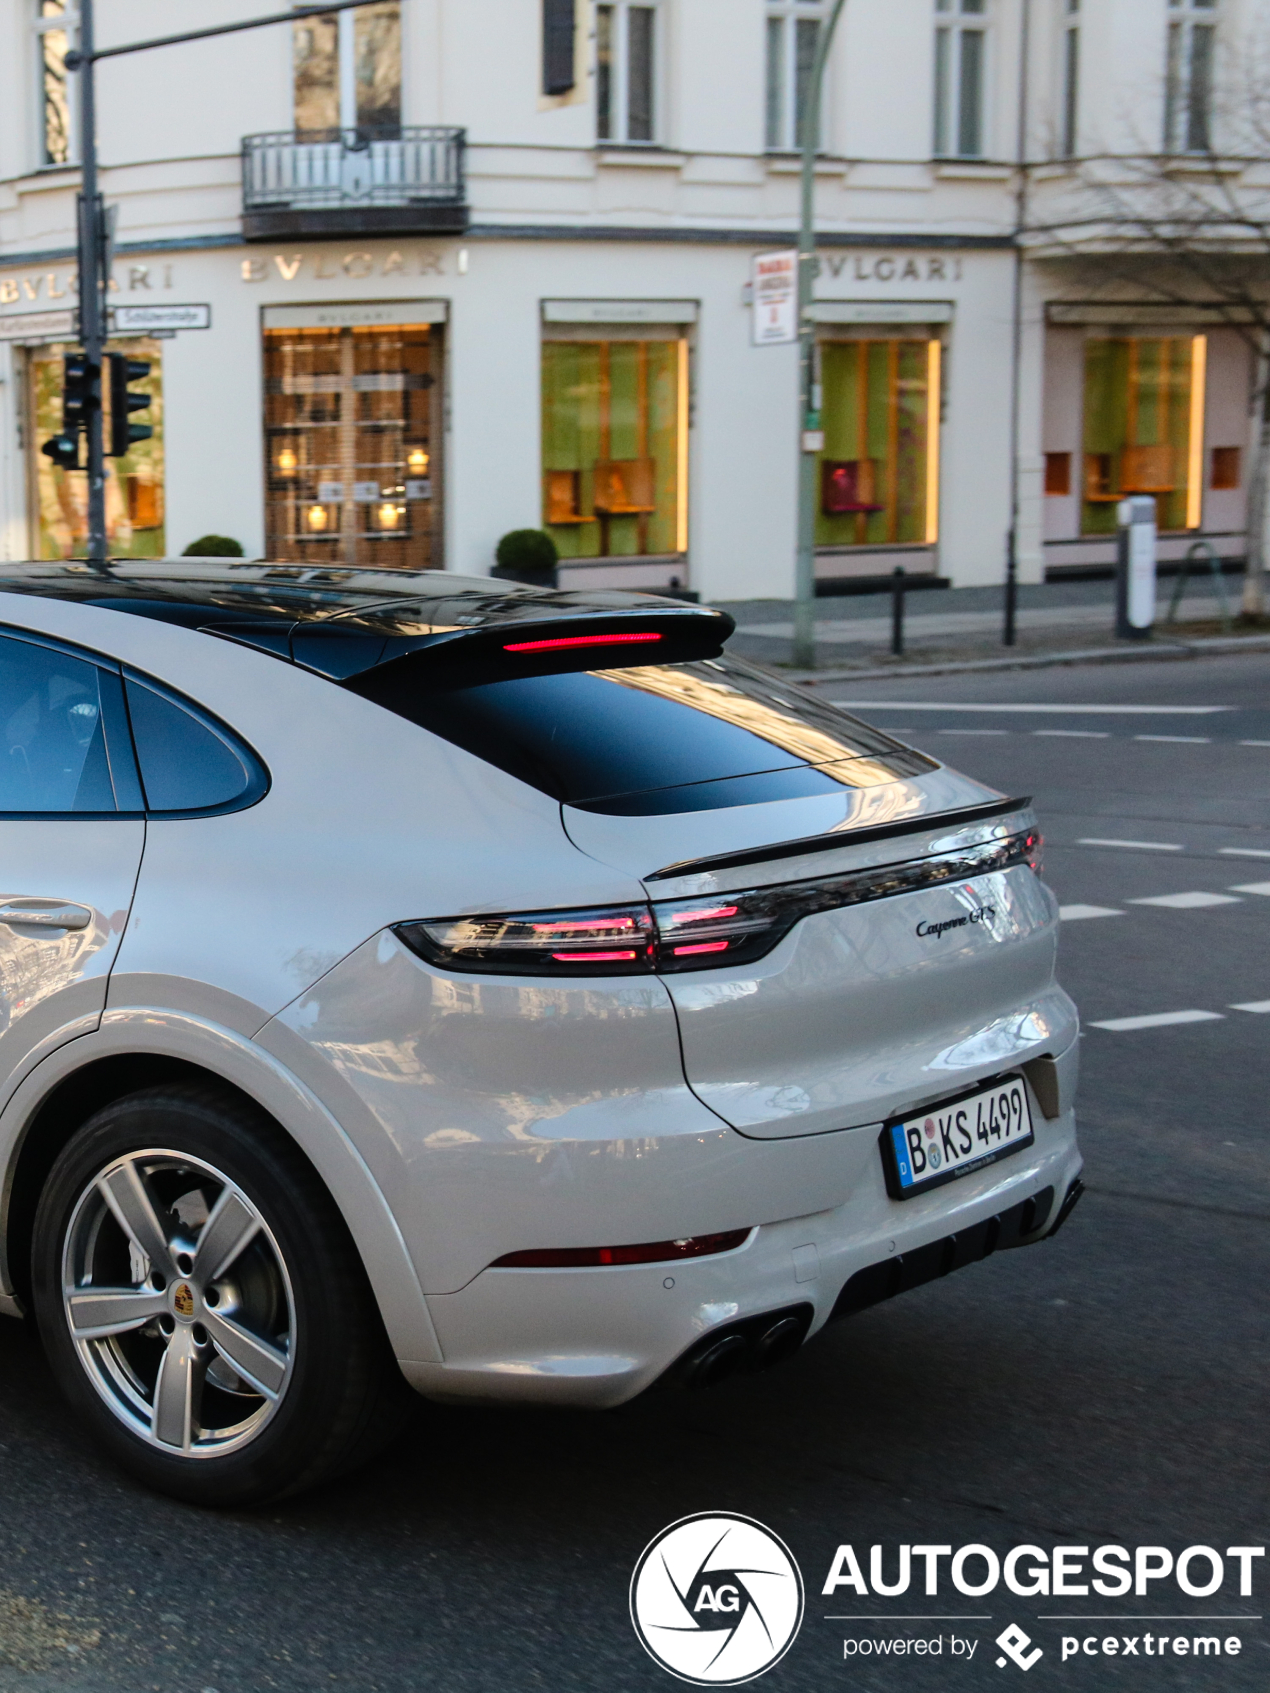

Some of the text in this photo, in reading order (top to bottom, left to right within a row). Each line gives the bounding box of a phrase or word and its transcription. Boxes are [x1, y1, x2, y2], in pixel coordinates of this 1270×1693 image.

[241, 249, 469, 282] BVLGARI
[916, 905, 996, 939] Cayenne GTS
[907, 1127, 927, 1174] B
[938, 1110, 972, 1163] KS
[977, 1087, 1023, 1145] 4499
[900, 1162, 907, 1175] D
